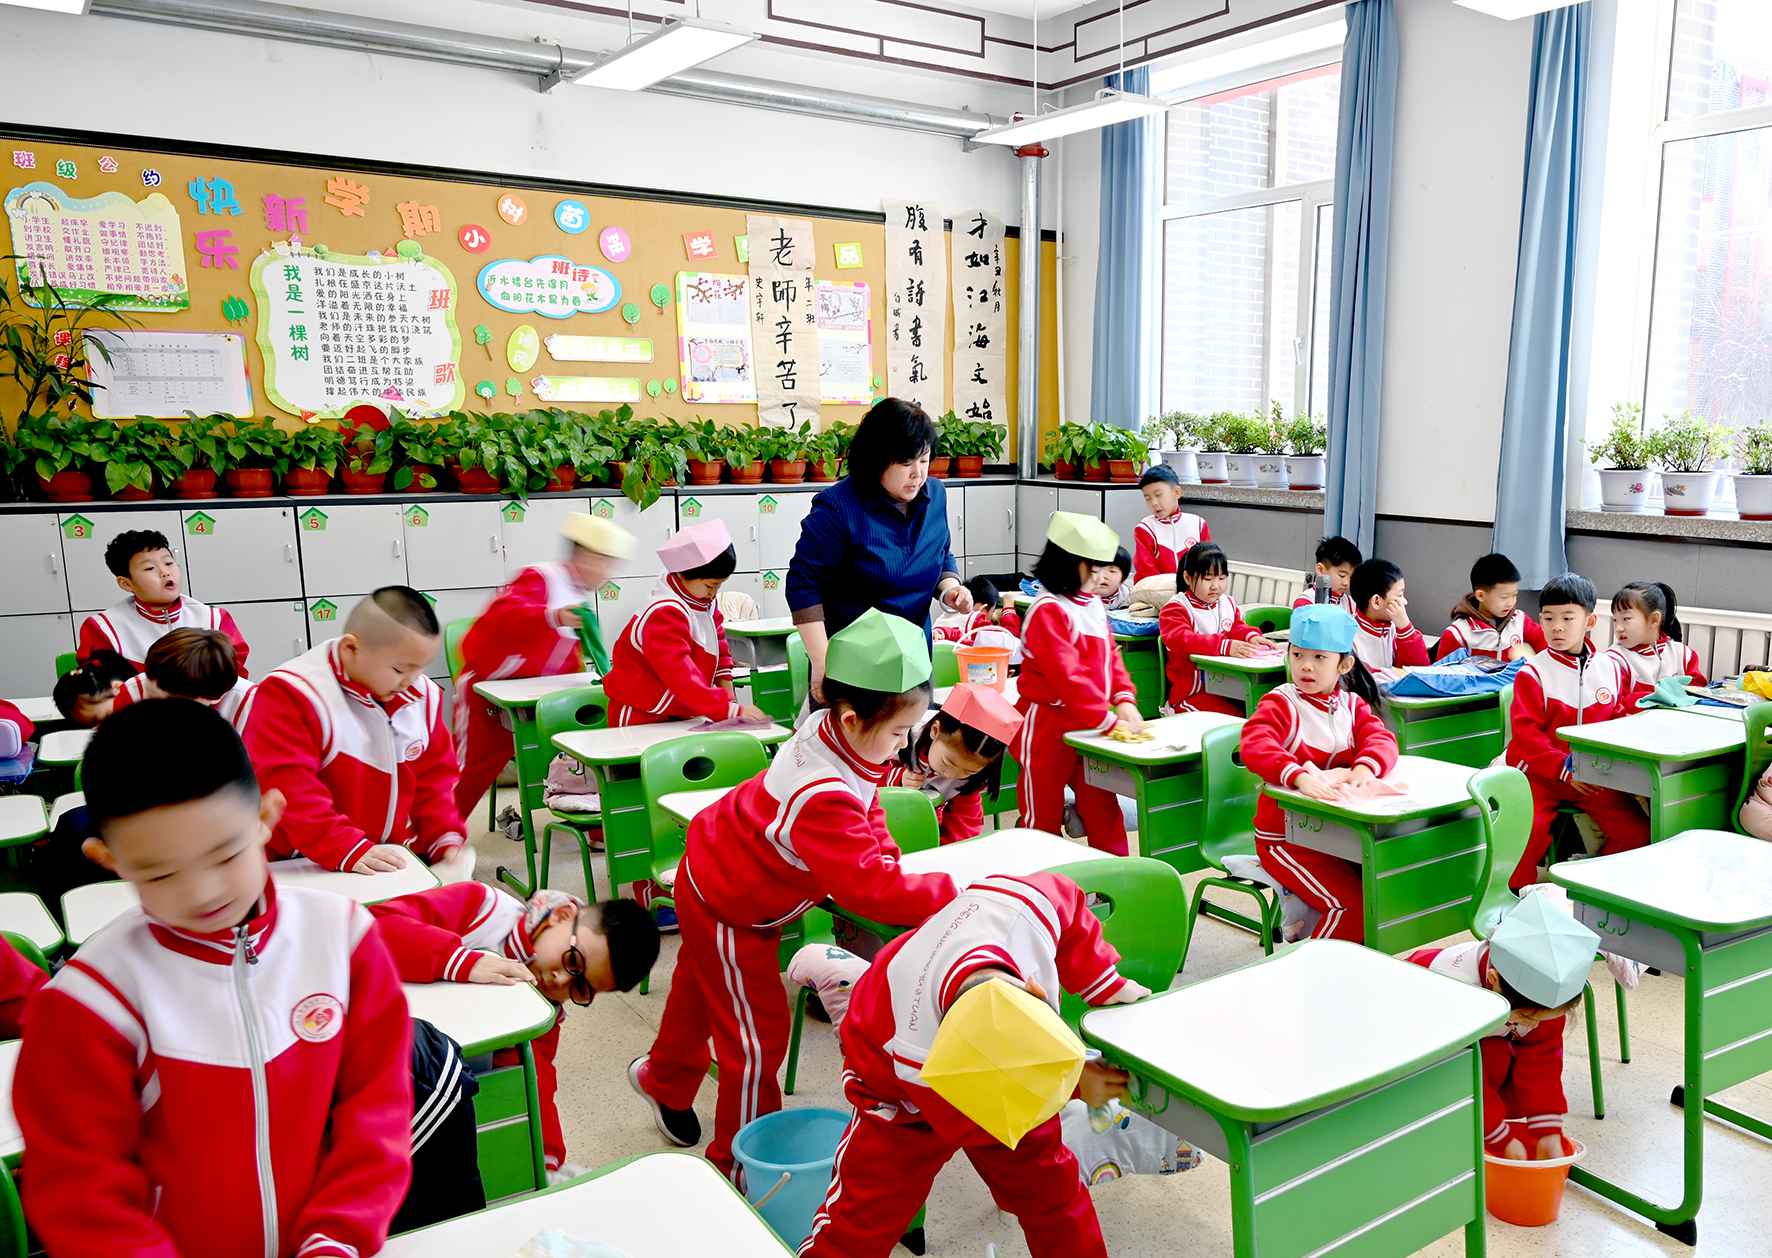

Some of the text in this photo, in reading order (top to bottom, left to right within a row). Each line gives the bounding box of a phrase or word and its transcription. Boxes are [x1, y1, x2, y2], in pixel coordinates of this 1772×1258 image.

[13, 151, 161, 186] 班级公约
[314, 266, 405, 280] 我们是成长的小树
[551, 261, 590, 282] 班诗
[315, 278, 417, 292] 扎根在盛京这片沃土
[487, 274, 568, 290] 近水楼台先得月
[316, 289, 406, 302] 爱的阳光洒在身上
[316, 300, 407, 313] 洋溢着无限的幸福
[283, 265, 309, 361] 我是一棵树
[318, 311, 431, 324] 我们是未来的参天大树
[320, 333, 410, 345] 向着天空多彩的梦
[321, 343, 411, 355] 要迈好起飞的脚步
[322, 354, 424, 366] 我们二班是个大家族
[323, 365, 413, 376] 团结奋进互帮互助
[600, 508, 607, 518] 8
[688, 506, 695, 516] 9
[763, 504, 773, 513] 10
[413, 515, 421, 525] 6
[510, 511, 518, 521] 7
[195, 522, 205, 533] 4
[310, 518, 319, 529] 5
[74, 525, 85, 537] 3
[764, 580, 776, 589] 22
[603, 590, 616, 599] 20
[317, 609, 331, 619] 17
